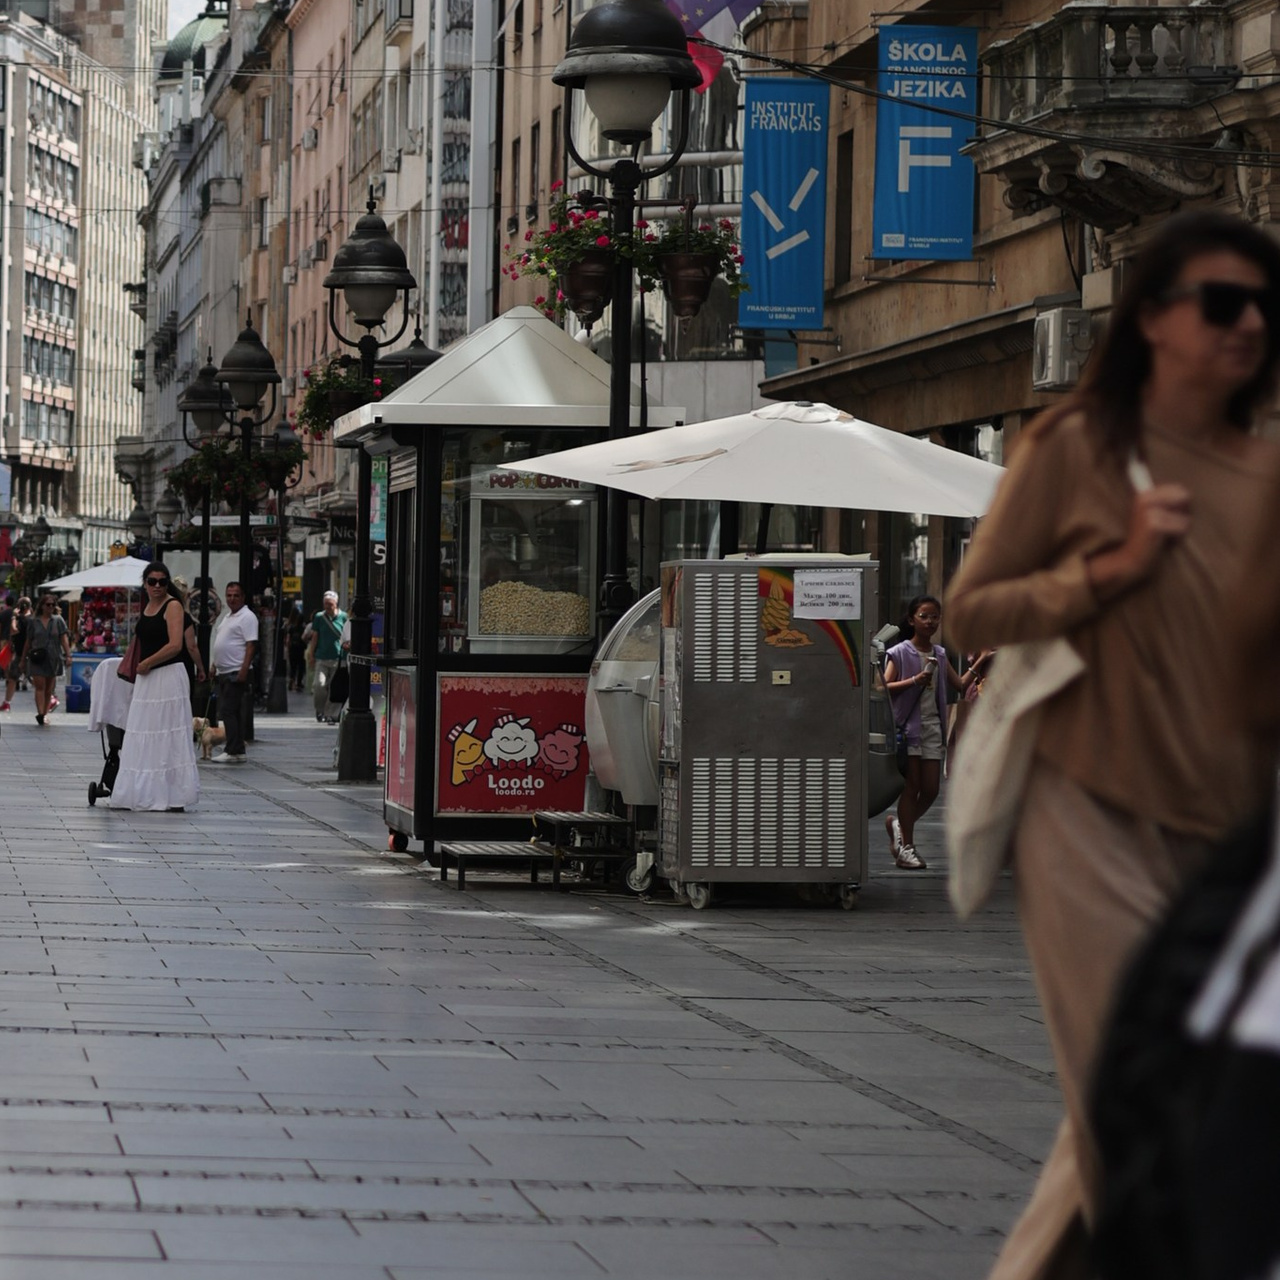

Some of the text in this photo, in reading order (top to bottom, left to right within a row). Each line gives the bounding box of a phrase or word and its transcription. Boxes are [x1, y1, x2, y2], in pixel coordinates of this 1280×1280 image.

[888, 39, 967, 62] ŠKOLA
[887, 80, 967, 98] JEZIKA
[751, 101, 816, 117] INSTITUT
[489, 471, 580, 489] POP CORN
[488, 774, 545, 789] Loodo
[495, 788, 535, 796] loodo.rs
